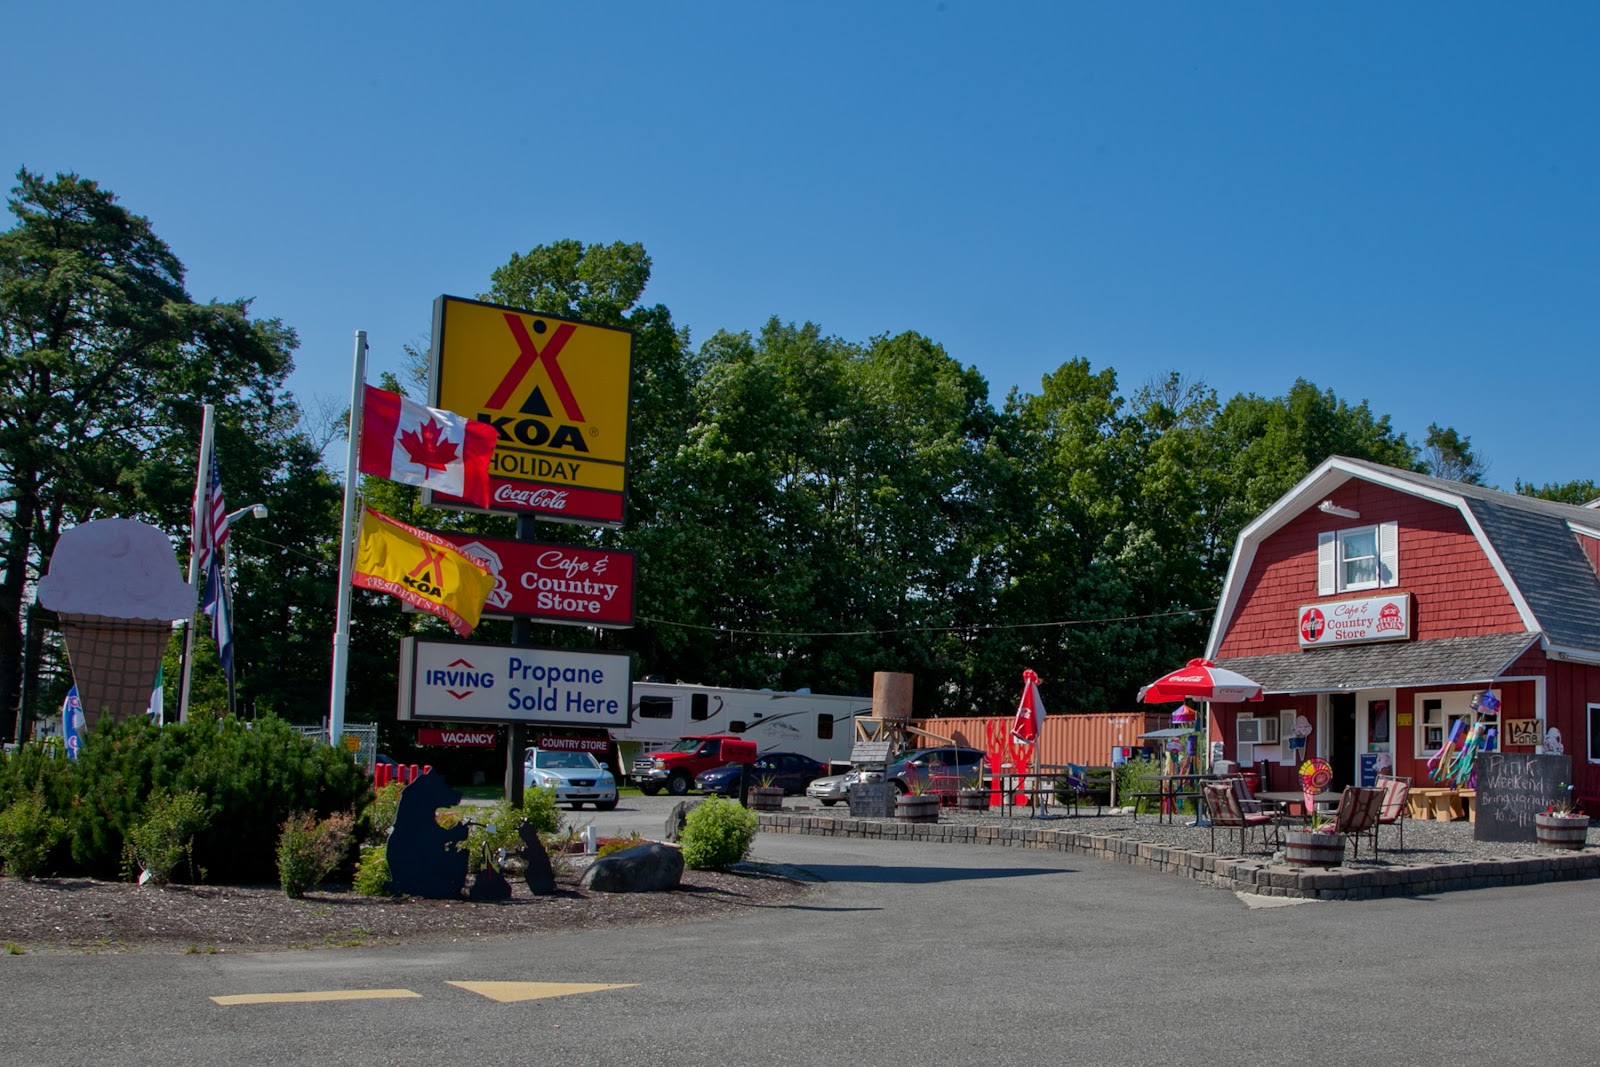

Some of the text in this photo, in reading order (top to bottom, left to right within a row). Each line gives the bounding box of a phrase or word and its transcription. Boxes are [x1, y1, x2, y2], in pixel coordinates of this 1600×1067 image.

[478, 413, 589, 452] KOA
[490, 453, 581, 481] HOLIDAY
[494, 484, 569, 509] Coca-Cola
[537, 551, 609, 578] Cafe &
[366, 577, 433, 609] PRESIDENT'S
[402, 575, 442, 598] KOA
[521, 572, 618, 600] Country
[537, 591, 601, 613] Store
[1334, 601, 1369, 619] Cafe &
[1327, 617, 1374, 629] Country
[1335, 629, 1366, 640] Store
[426, 669, 494, 688] IRVING
[509, 657, 604, 688] Propane
[508, 687, 618, 714] Sold Here
[441, 733, 494, 744] VACANCY
[542, 738, 607, 750] COUNTRY STORE
[1494, 808, 1505, 821] to
